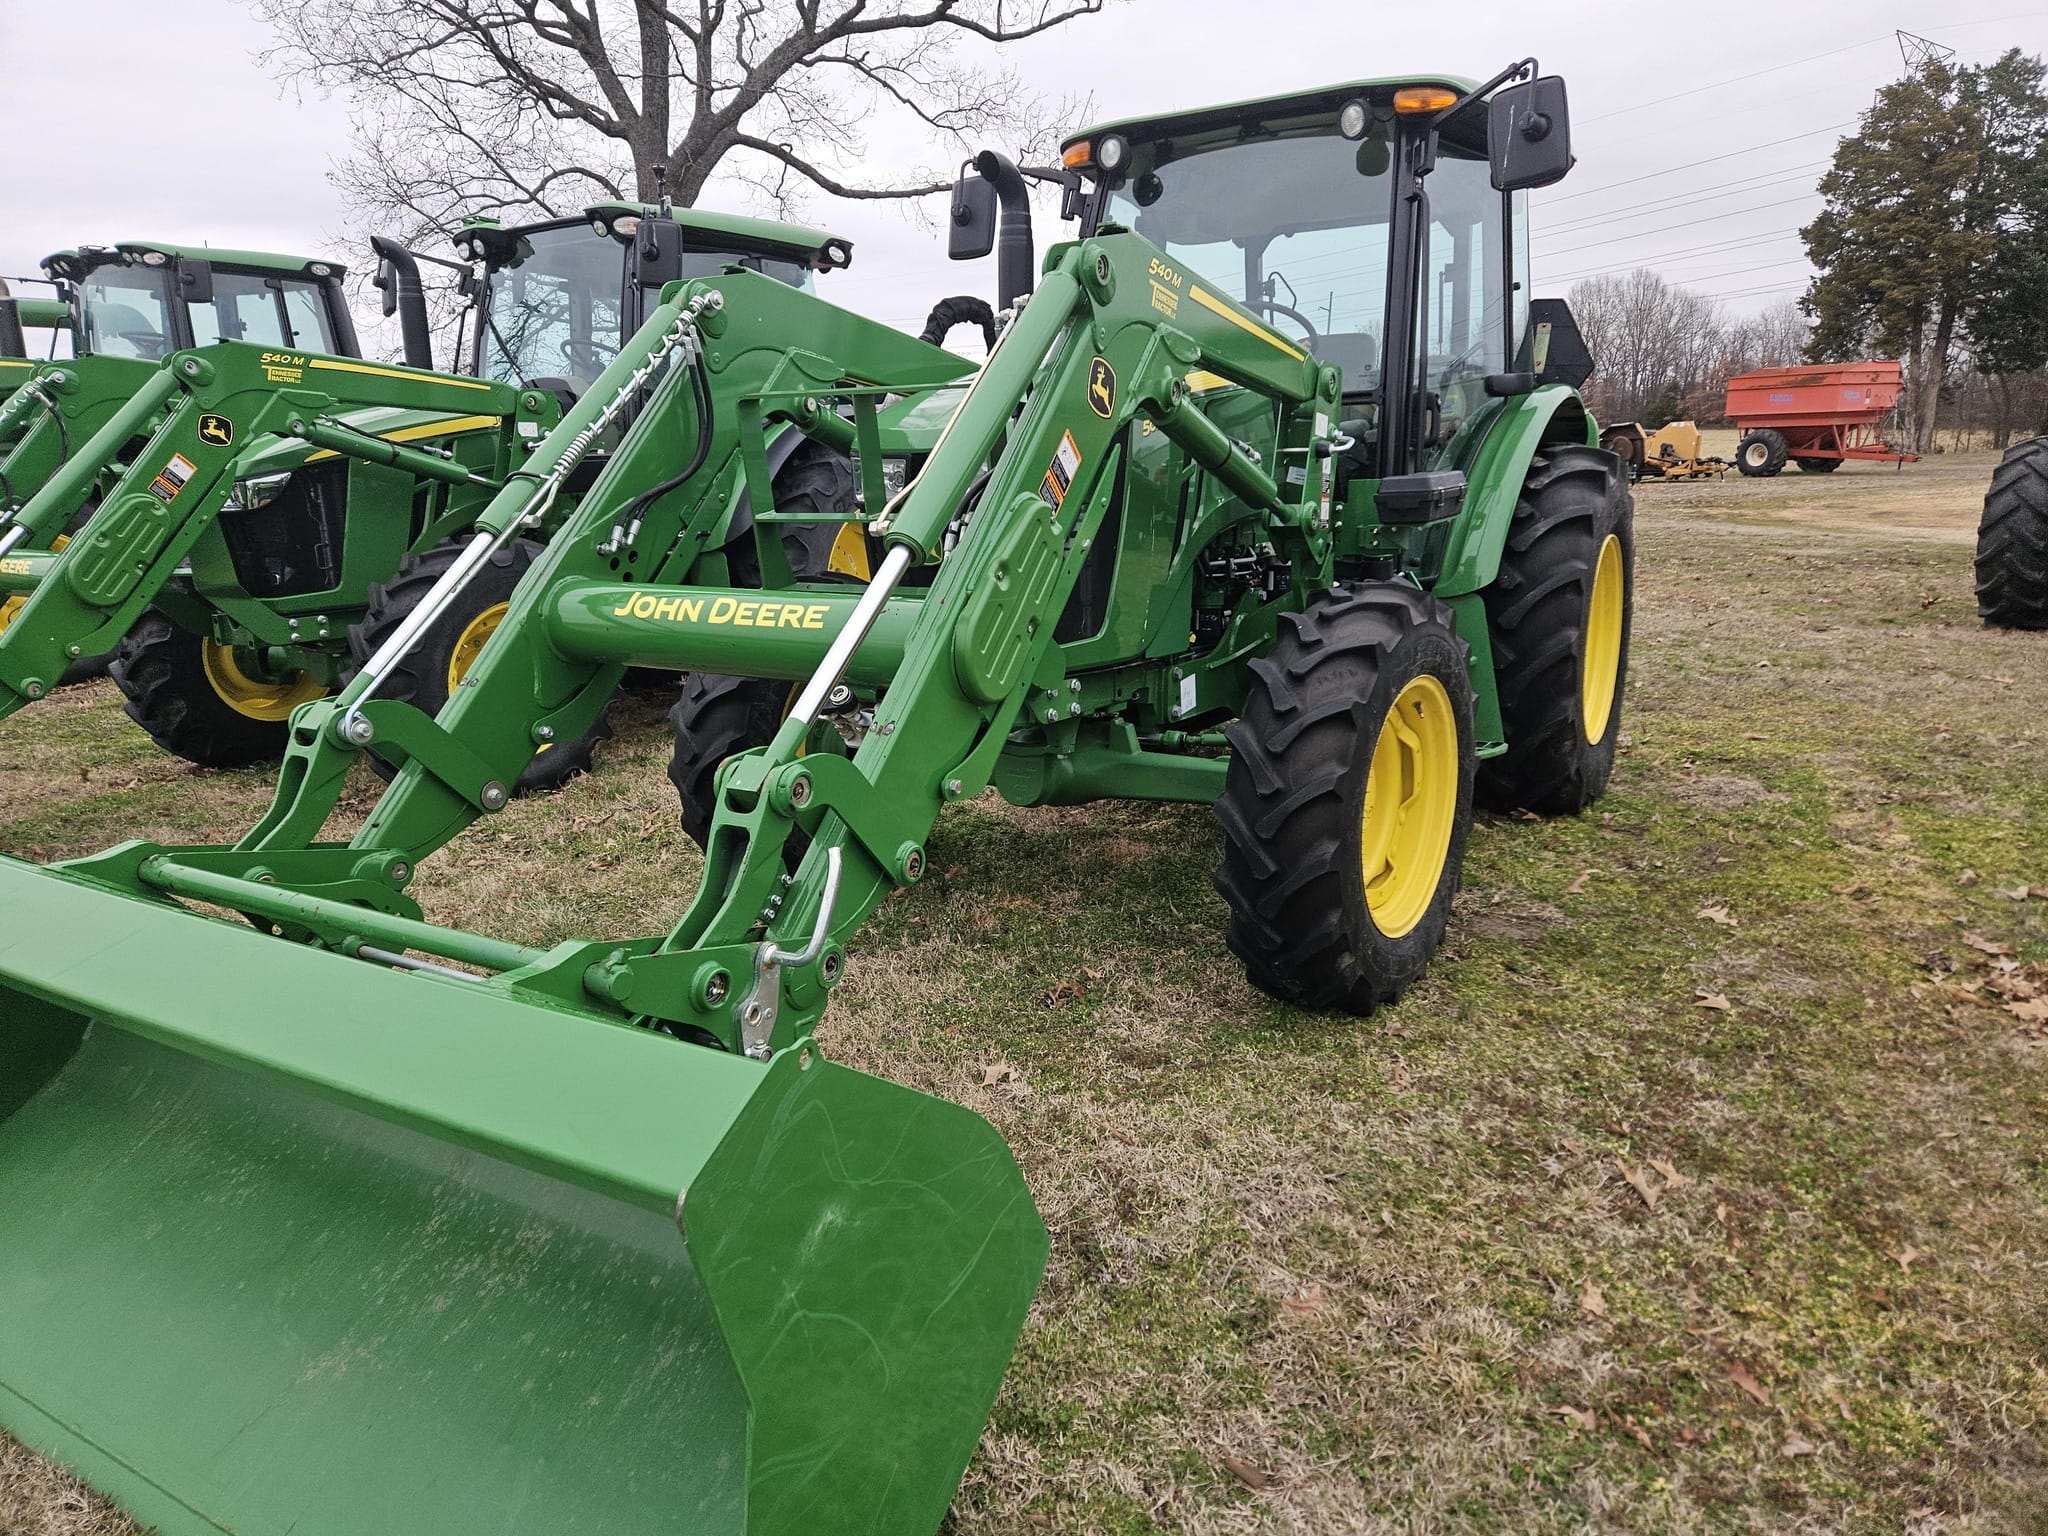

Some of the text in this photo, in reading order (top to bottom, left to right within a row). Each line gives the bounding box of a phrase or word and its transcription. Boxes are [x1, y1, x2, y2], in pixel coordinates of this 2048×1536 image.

[0, 558, 33, 575] EERE
[614, 591, 831, 629] JOHN DEERE
